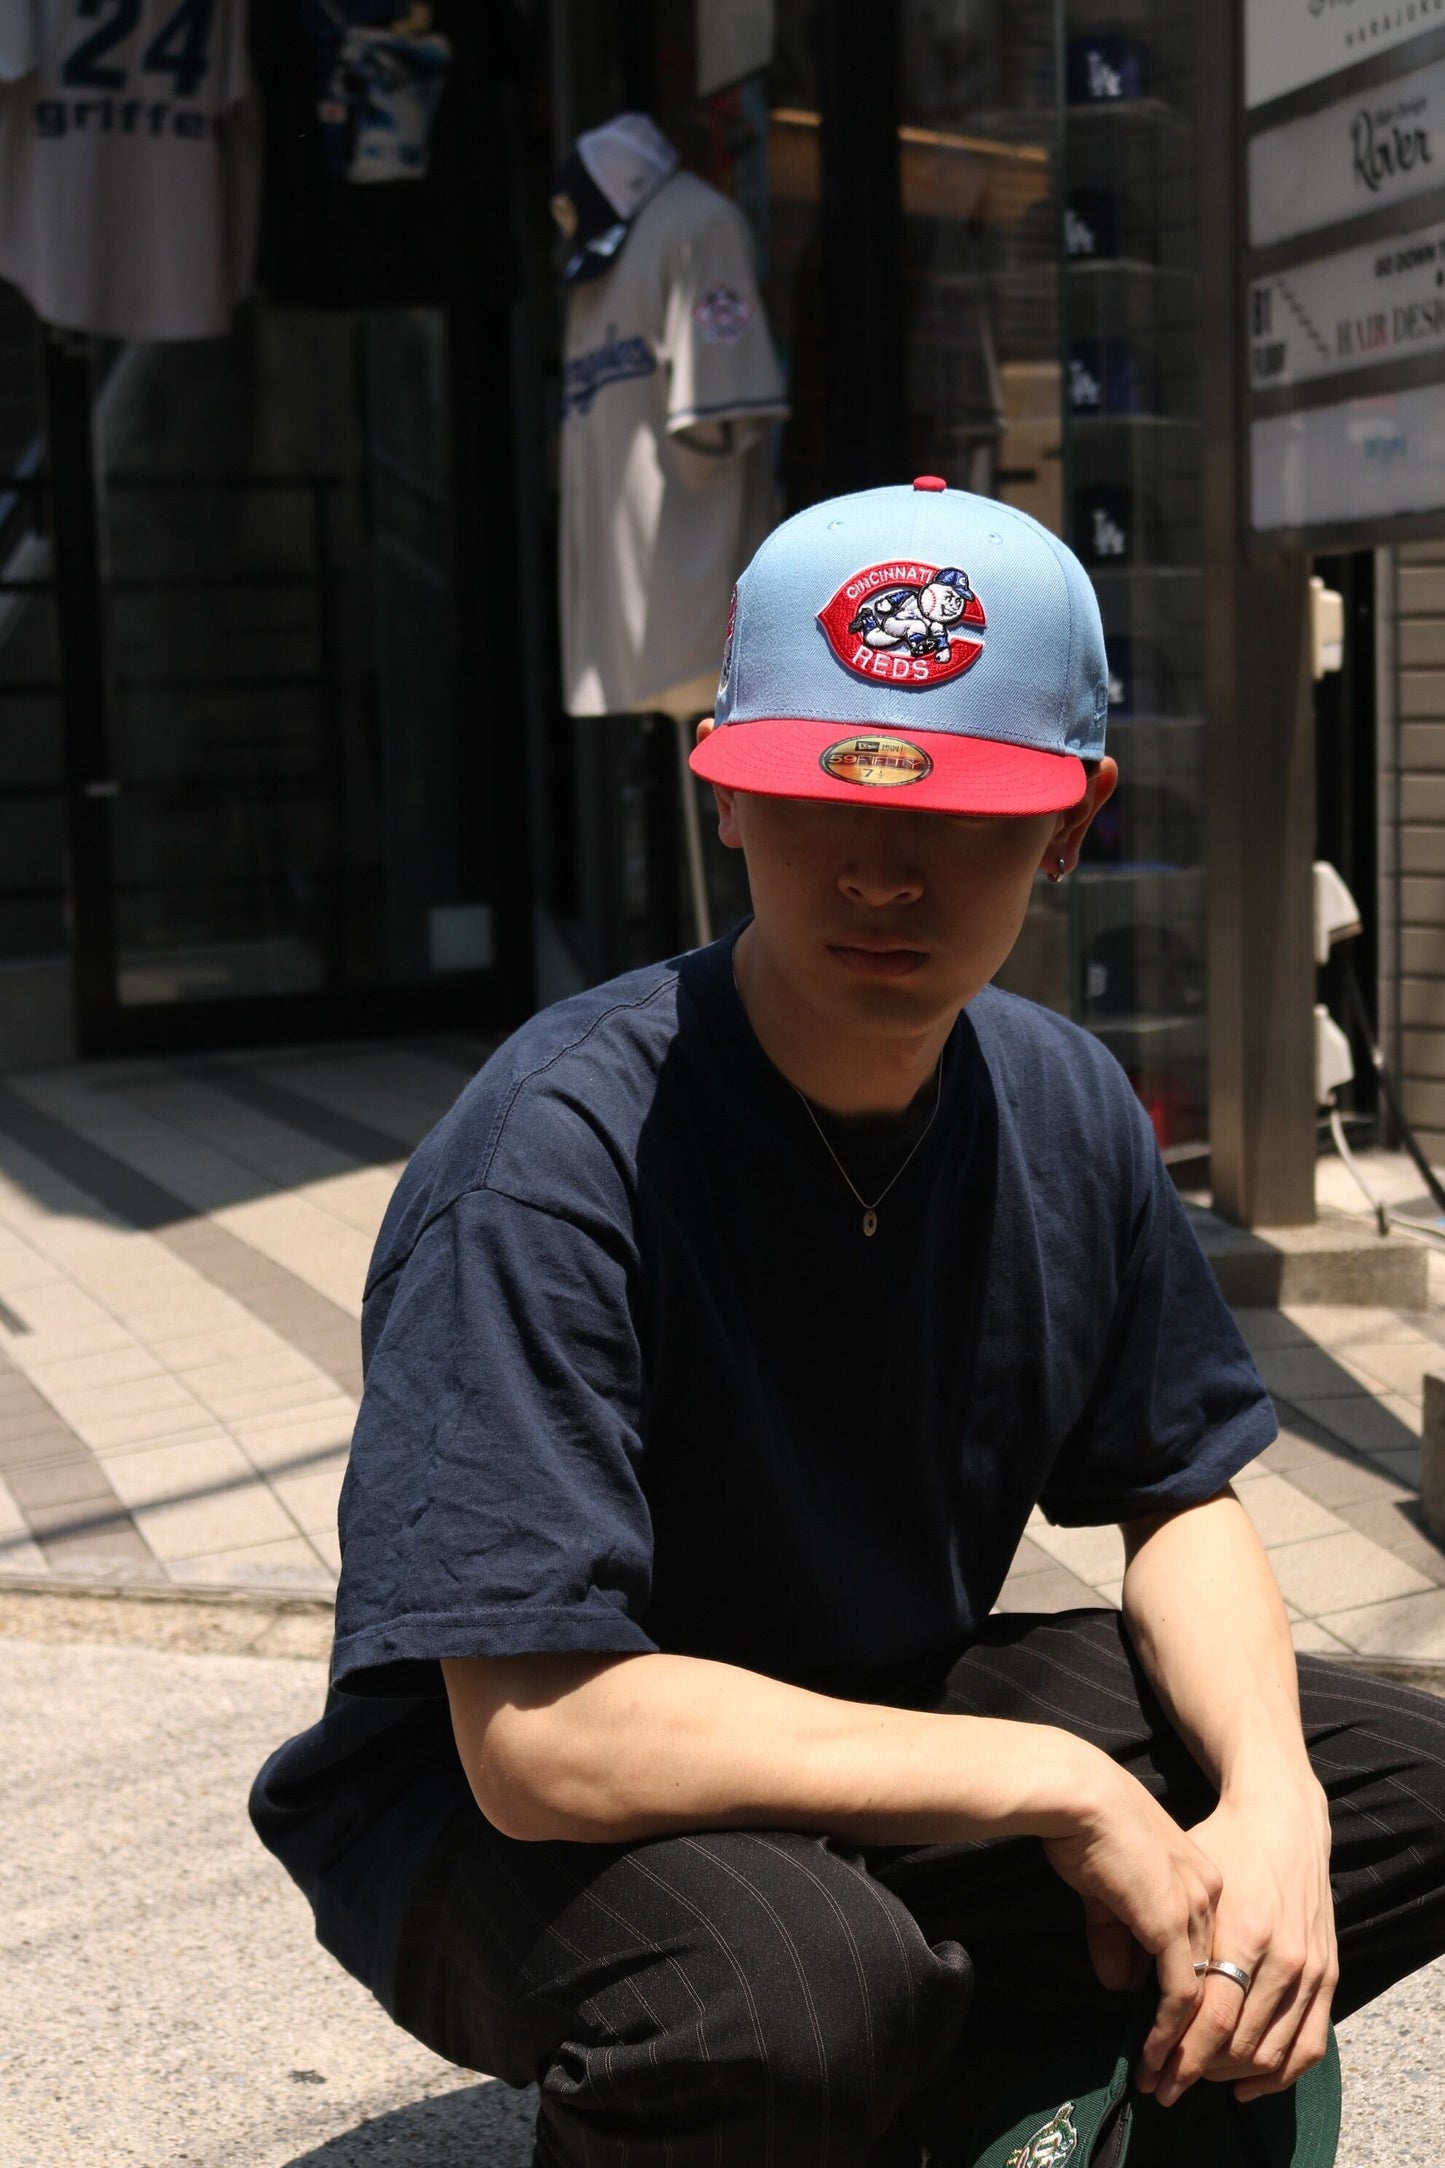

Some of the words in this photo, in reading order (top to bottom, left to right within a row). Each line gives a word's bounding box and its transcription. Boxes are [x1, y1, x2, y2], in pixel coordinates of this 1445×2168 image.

[62, 0, 211, 95] 24
[36, 100, 224, 138] griffe
[1337, 312, 1389, 355] HAIR
[846, 566, 933, 599] CINCINNATI
[852, 645, 930, 680] REDS
[828, 754, 922, 769] 59FIFTY
